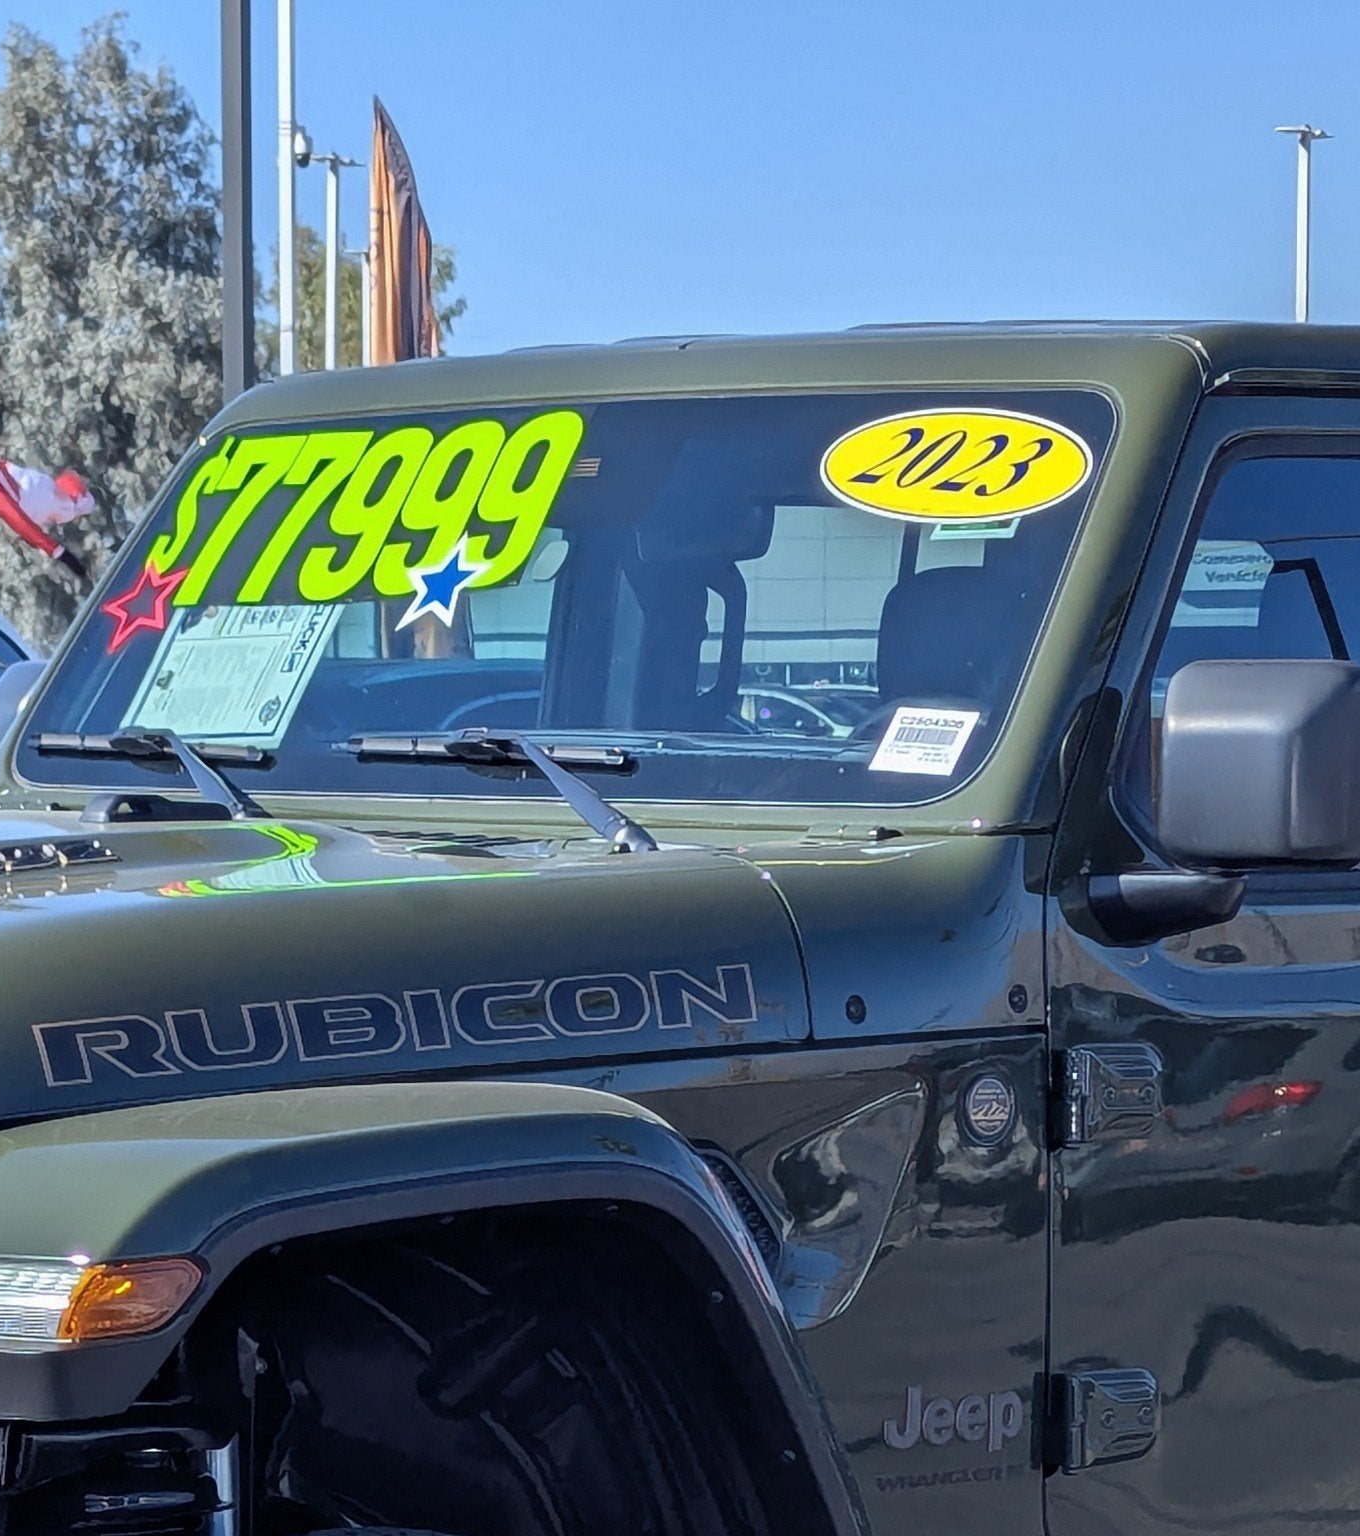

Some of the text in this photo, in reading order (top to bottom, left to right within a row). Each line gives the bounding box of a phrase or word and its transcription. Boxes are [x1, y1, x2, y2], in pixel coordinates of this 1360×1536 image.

[145, 410, 584, 606] $77999
[847, 427, 1053, 496] 2023
[32, 963, 760, 1088] RUBICON
[883, 1384, 1024, 1452] Jeep
